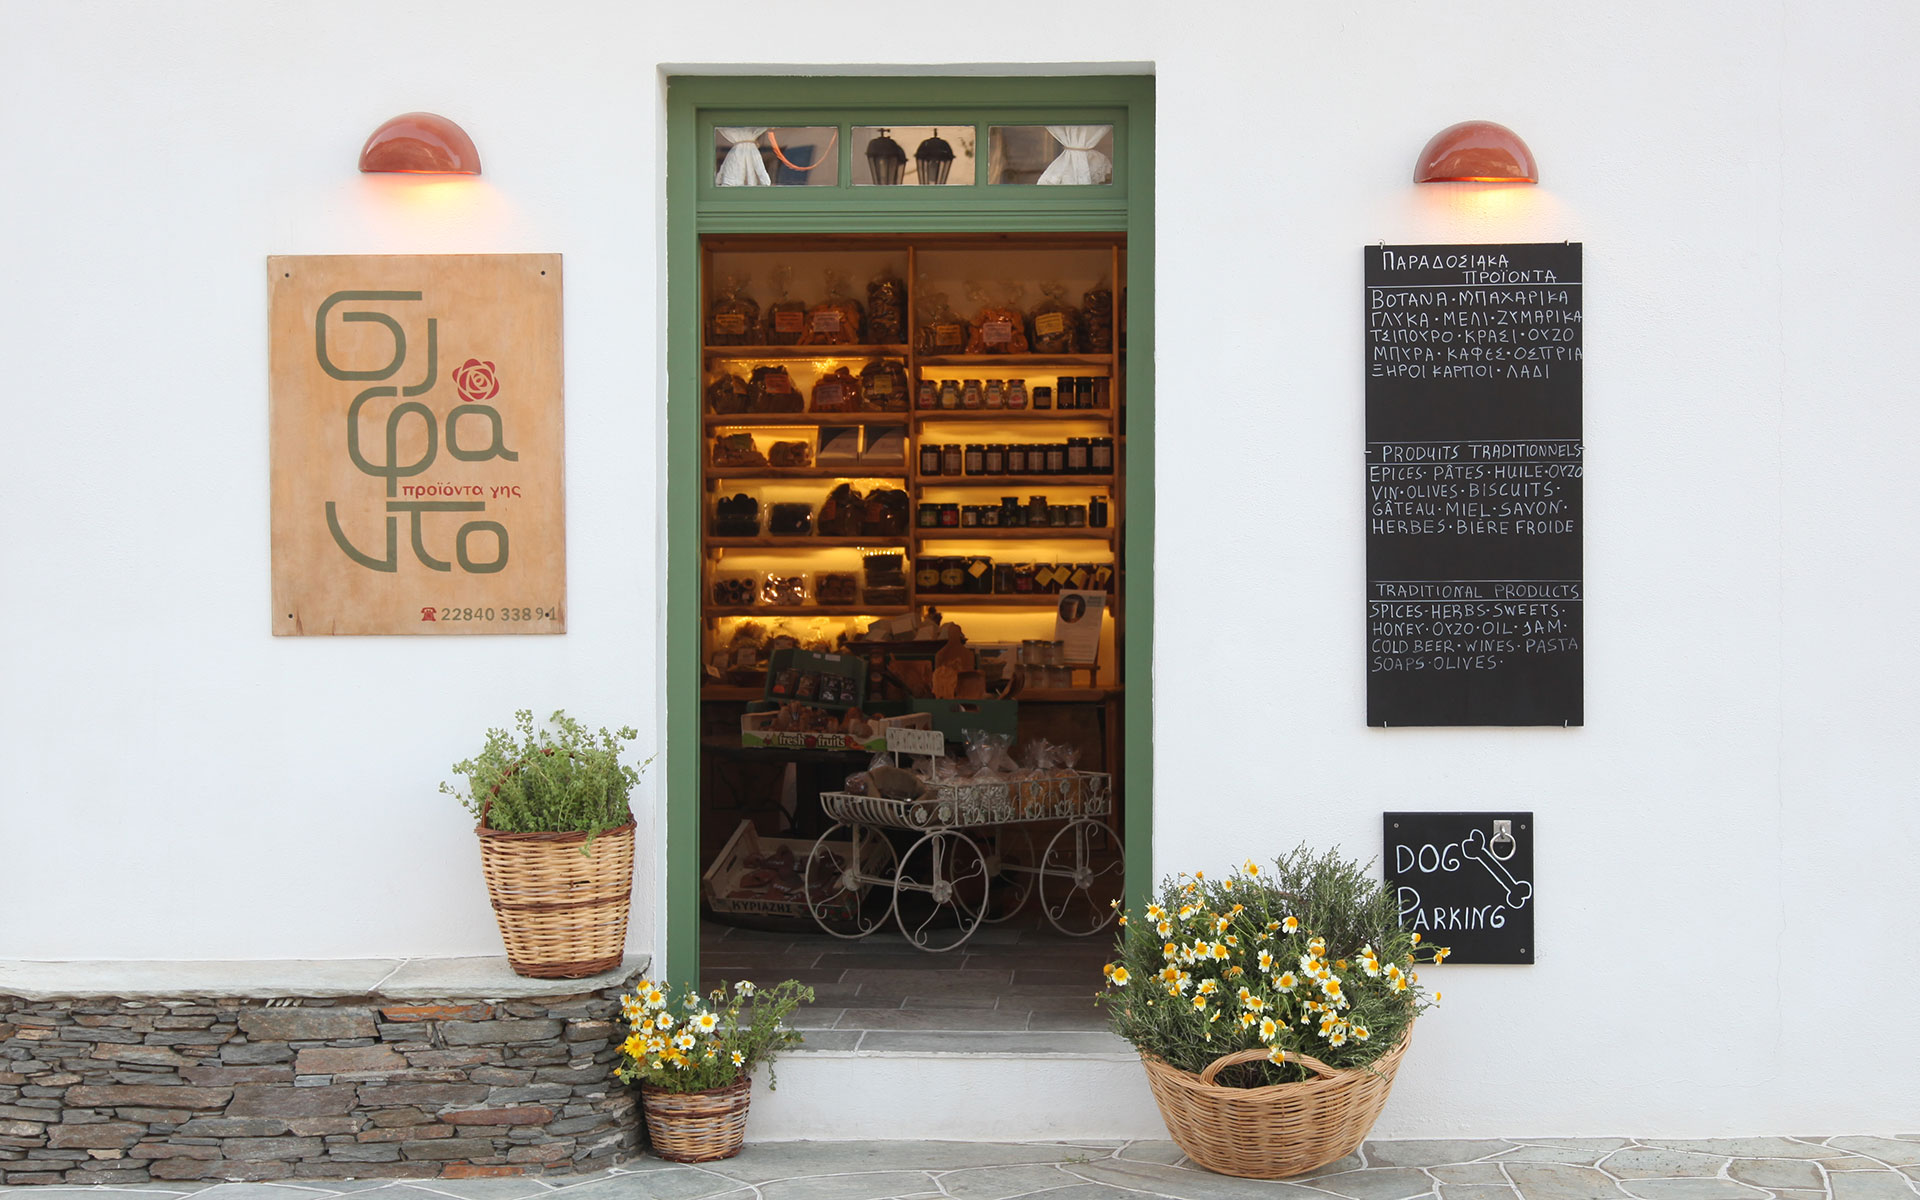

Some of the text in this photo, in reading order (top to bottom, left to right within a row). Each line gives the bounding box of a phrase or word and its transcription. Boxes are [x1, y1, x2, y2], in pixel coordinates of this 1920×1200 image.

[1383, 251, 1509, 270] ΠΑΡΑΔΟΣΙΑΚΑ
[1372, 289, 1567, 309] ΒΟΤΑΝΑ ΜΠΑΧΑΡΙΚΑ
[1372, 310, 1581, 328] ΓΛΥΚΑ ΜΕΛΙ ΖΥΜΑΡΙΚΑ
[1370, 328, 1574, 344] ΤΣΙΠΟΥΡΟ ΚΡΑΣΙ ΟΥΖΟ
[1374, 346, 1433, 362] ΜΠΥΡΑ
[1514, 346, 1581, 361] ΟΣΠΡΙΑ
[1372, 364, 1548, 379] ΞΗΡΟΙ ΚΑΡΠΟΙ ΛΑΔΙ
[1383, 444, 1580, 462] PRODUITS TRADITIONNELS
[1370, 466, 1422, 482] EPICES
[1434, 465, 1483, 480] PÂTES
[1495, 465, 1543, 479] HUILE
[402, 481, 522, 499] προϊόντα γης
[1372, 481, 1553, 501] VIN OLIVES BISCUITS
[1373, 500, 1563, 517] GÂTEAU MIEL SAVON
[1373, 518, 1445, 534] HERBES
[1516, 520, 1573, 535] FROIDE
[1376, 584, 1579, 599] TRADITIONAL PRODUCTS
[441, 608, 495, 621] 22840
[1369, 603, 1558, 619] SPICES HERBS SWEETS
[1373, 622, 1424, 636] HONEY
[1483, 622, 1512, 635] OIL
[1522, 619, 1561, 636] JAM
[1372, 638, 1577, 653] COLD BEER WINES PASTA
[1372, 655, 1496, 672] SOAPS OLIVES
[779, 733, 846, 747] fresh fruits
[1396, 843, 1460, 873] DOG
[1398, 886, 1506, 932] PARKING
